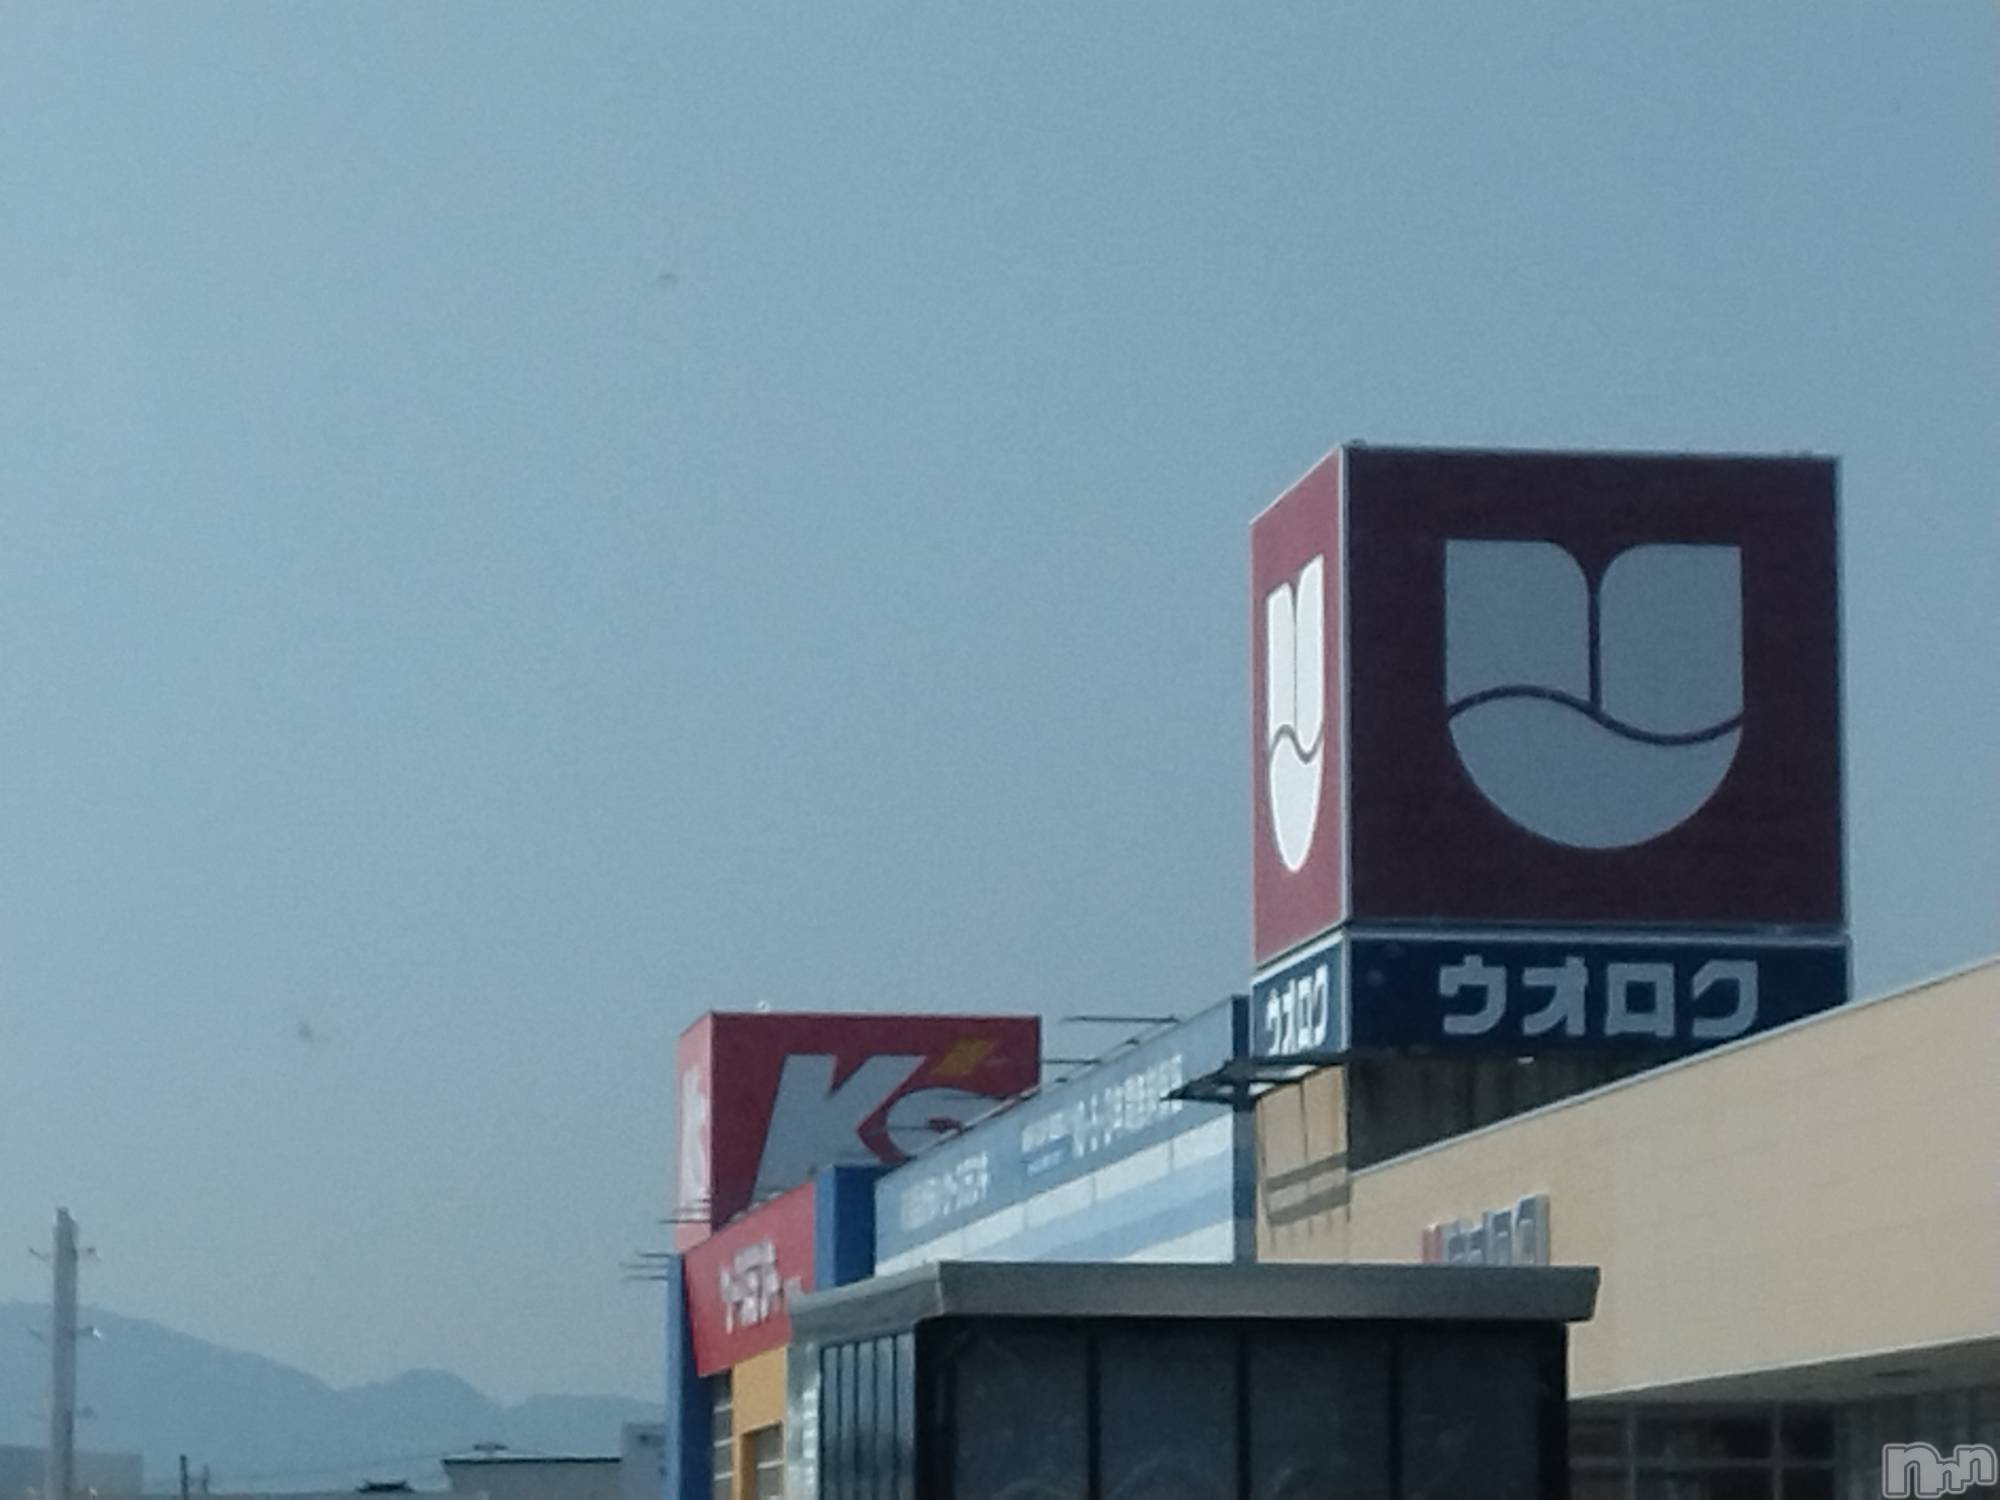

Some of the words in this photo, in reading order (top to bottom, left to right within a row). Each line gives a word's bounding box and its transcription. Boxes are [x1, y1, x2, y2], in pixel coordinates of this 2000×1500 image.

[1265, 966, 1328, 1056] ウオロク
[1440, 955, 1758, 1037] ウオロク
